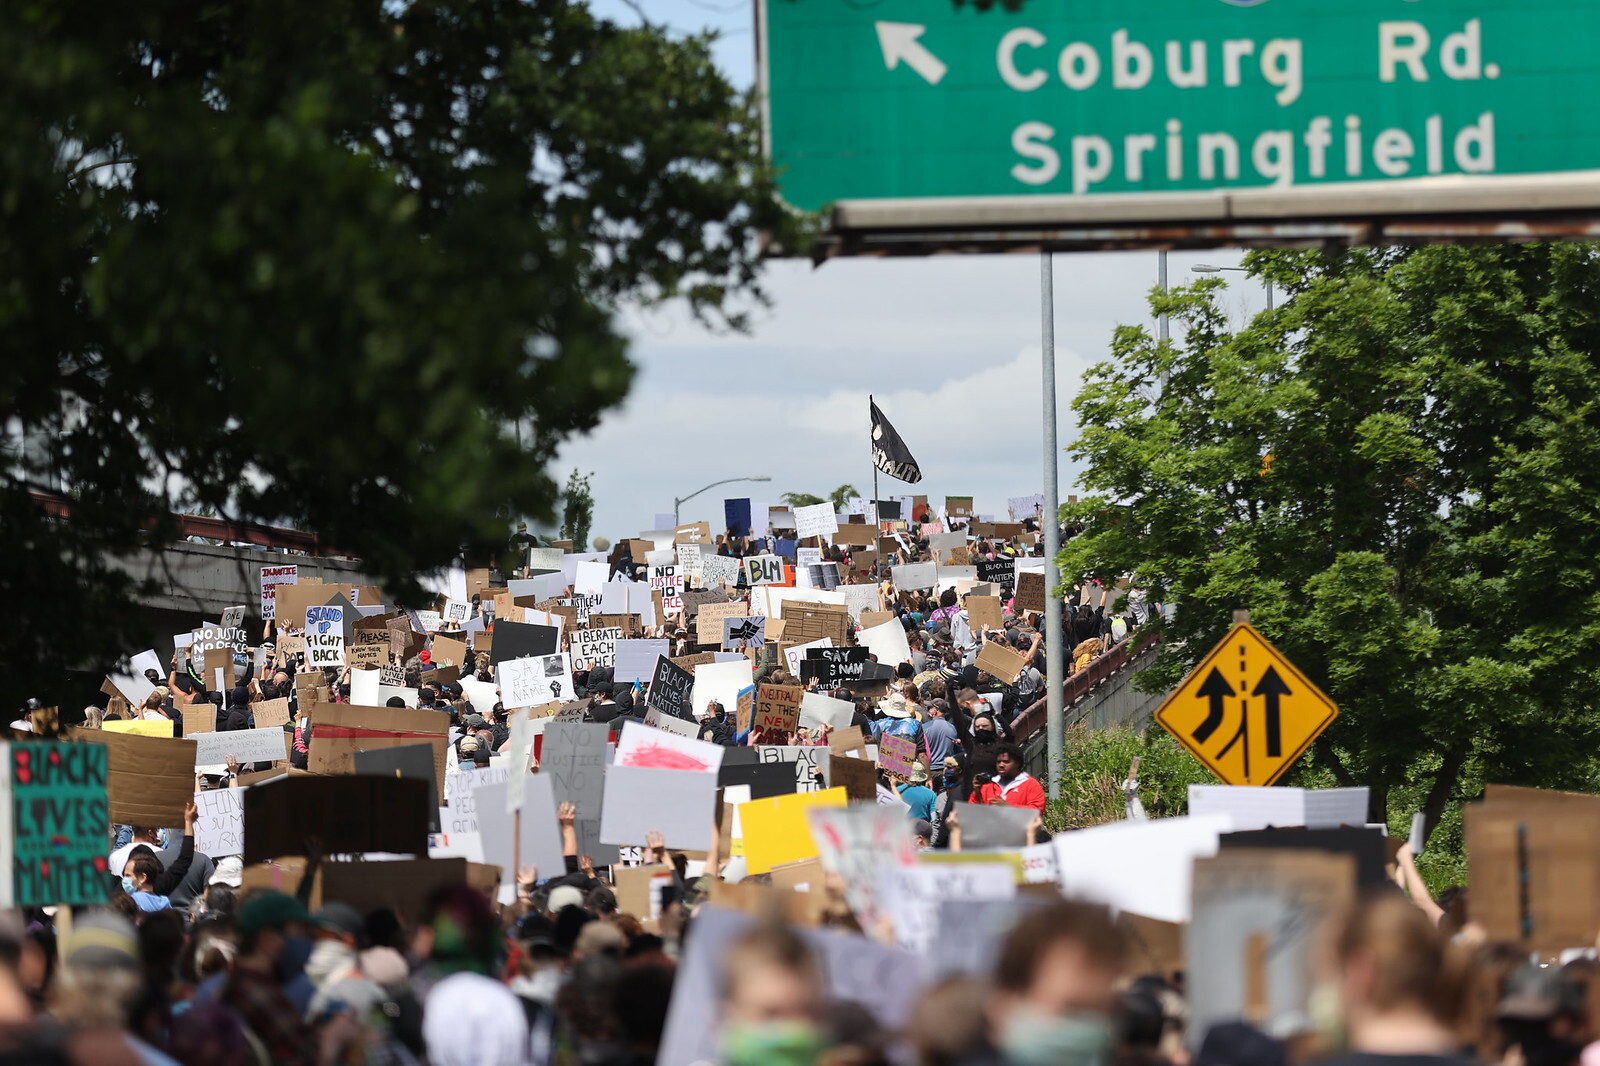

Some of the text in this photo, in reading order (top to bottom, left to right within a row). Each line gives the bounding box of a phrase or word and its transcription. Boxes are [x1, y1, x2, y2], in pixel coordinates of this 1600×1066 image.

[998, 18, 1501, 106] Coburg Rd.
[1010, 110, 1498, 195] Springfield
[655, 566, 675, 577] NO
[750, 559, 781, 582] BLM
[985, 563, 1003, 572] BLACK
[650, 575, 683, 587] JUSTICE
[986, 573, 1014, 582] MATTER
[663, 597, 681, 608] ACE
[306, 606, 343, 625] STAND
[576, 608, 591, 619] EACE
[194, 626, 248, 642] NO JUSTICE
[318, 621, 331, 634] UP
[306, 634, 343, 648] FIGHT
[570, 628, 622, 644] LIBERATE
[194, 641, 248, 655] NO PEACE
[312, 649, 340, 662] BACK
[581, 642, 615, 656] EACH
[822, 650, 851, 662] SAY
[382, 664, 404, 674] BLACK
[384, 671, 404, 680] LIVES
[509, 658, 543, 681] SAY
[838, 662, 863, 675] NAM
[513, 675, 540, 689] HIS
[659, 662, 692, 693] BLACK
[512, 684, 547, 703] NAME
[660, 683, 682, 705] LIVES
[760, 688, 798, 703] NEUTRAL
[651, 691, 681, 718] MATTER
[759, 702, 796, 717] IS THE
[763, 716, 792, 728] NEW
[561, 728, 591, 746] NO
[542, 747, 601, 767] JUSTICE
[764, 748, 817, 765] BLAC
[13, 747, 105, 786] BLACK
[882, 766, 910, 782] EORGE
[446, 767, 512, 796] STOP KILLIN
[554, 770, 587, 791] NO
[455, 796, 477, 815] PEO
[218, 832, 245, 850] RAC
